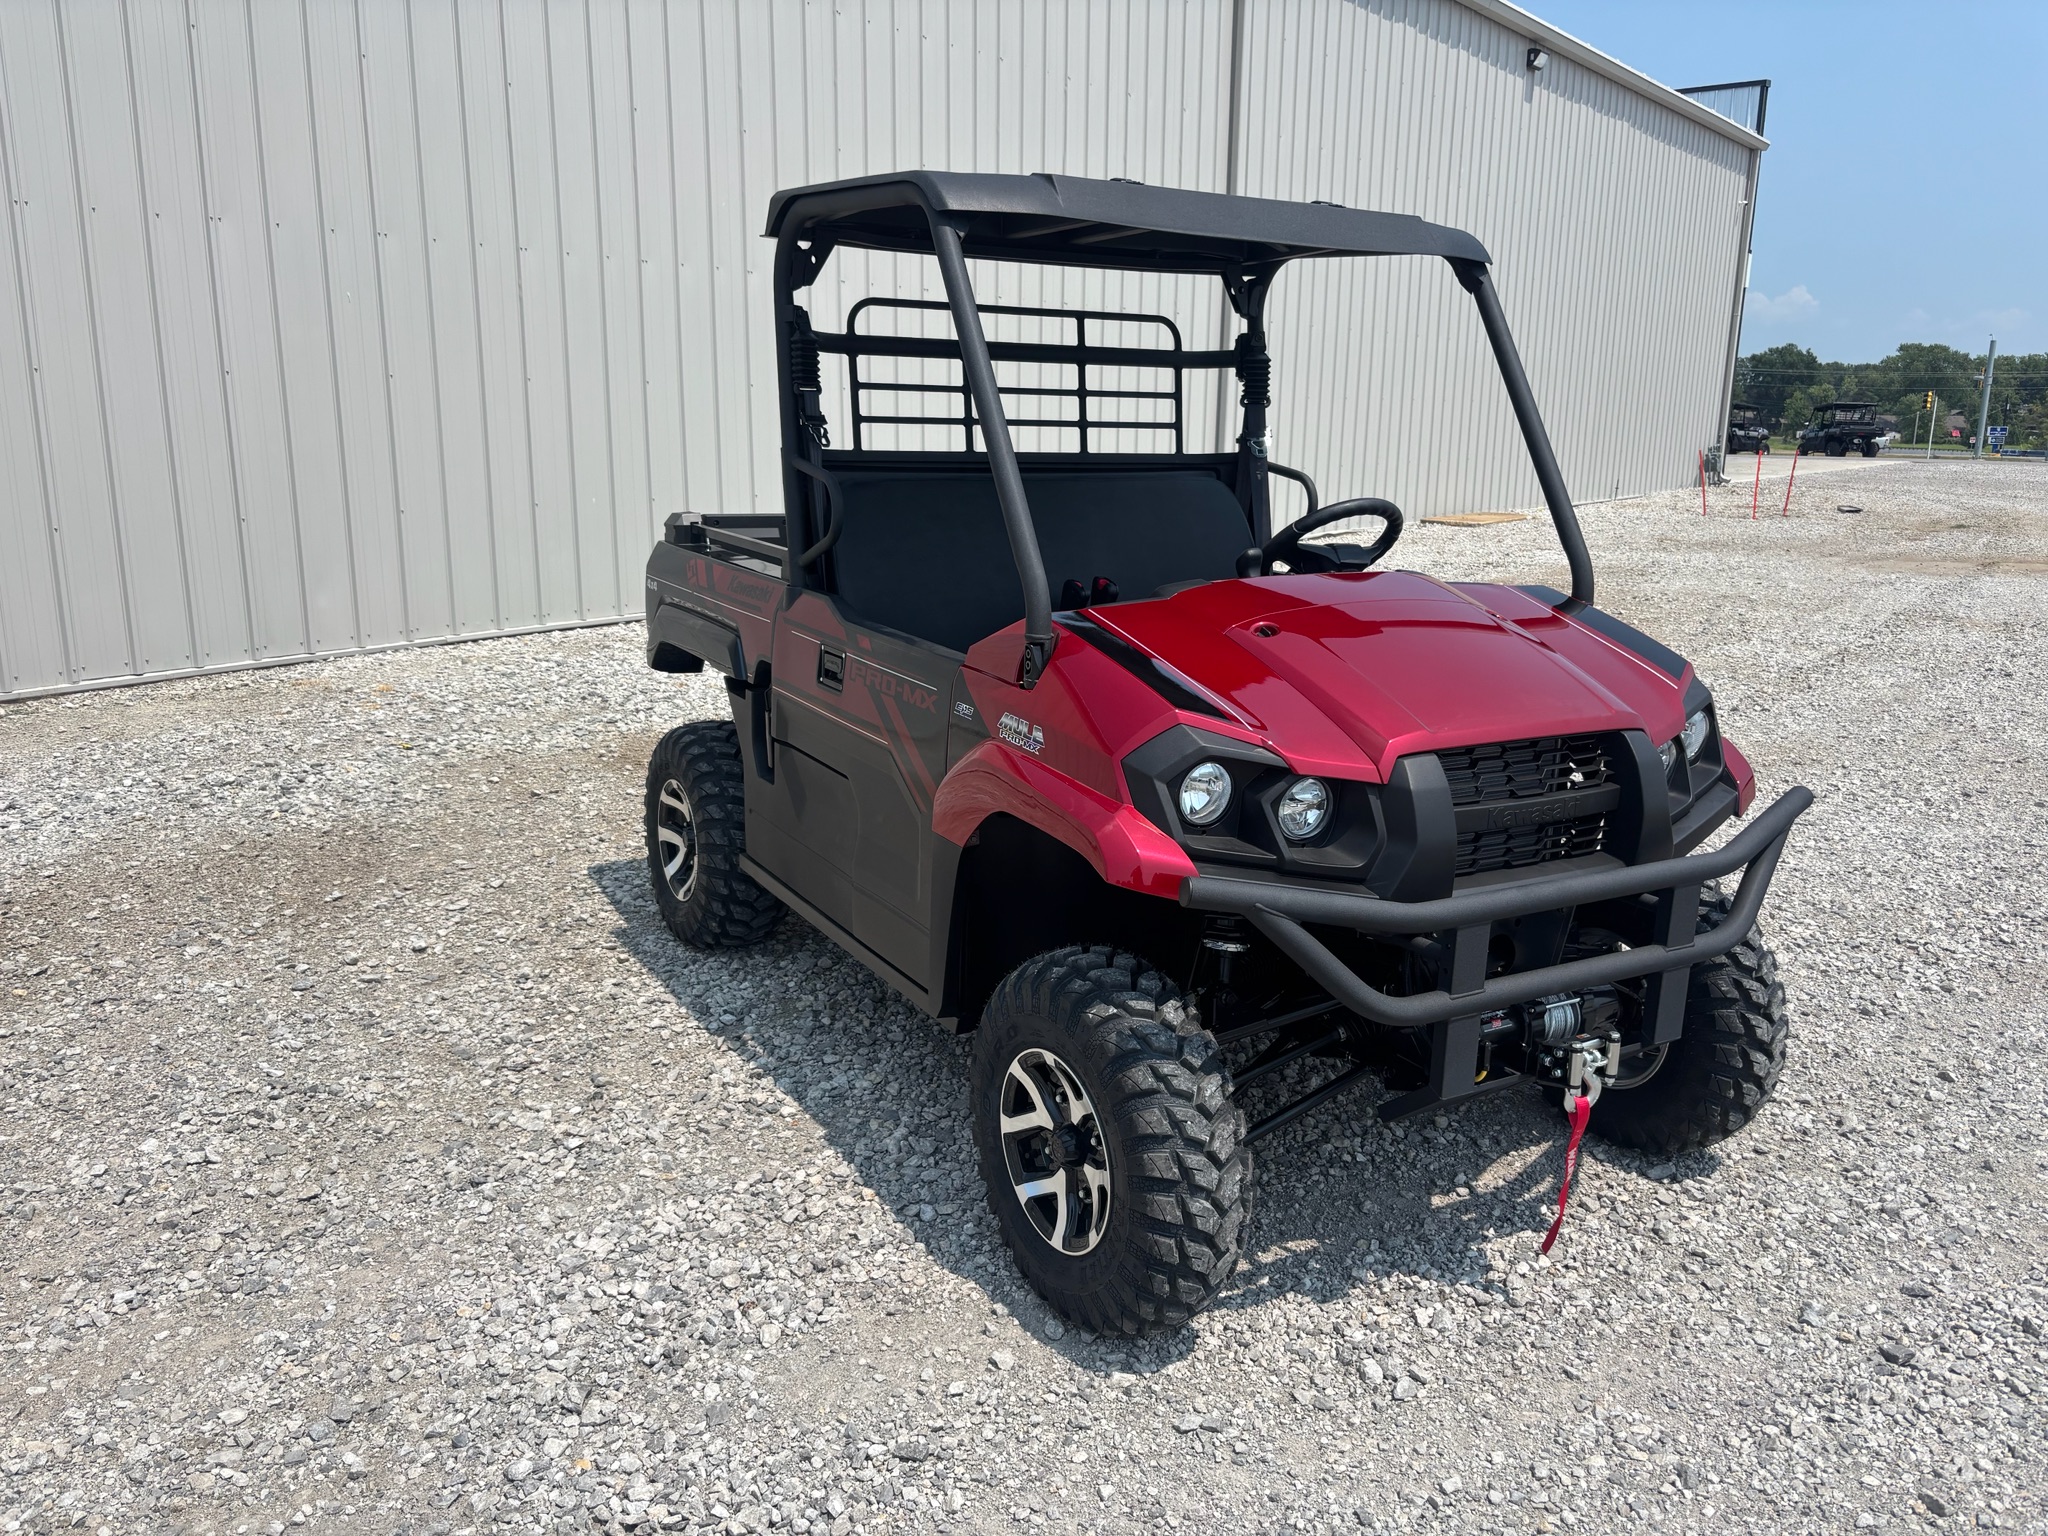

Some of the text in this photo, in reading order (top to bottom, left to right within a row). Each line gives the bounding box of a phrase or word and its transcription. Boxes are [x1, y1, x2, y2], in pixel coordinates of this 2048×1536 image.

[647, 579, 658, 592] 4x4
[727, 574, 774, 604] Kawasaki
[850, 660, 938, 714] PRO-MX
[997, 712, 1046, 749] MULE
[999, 728, 1040, 755] PRO-MX
[1487, 796, 1581, 831] Kawasaki
